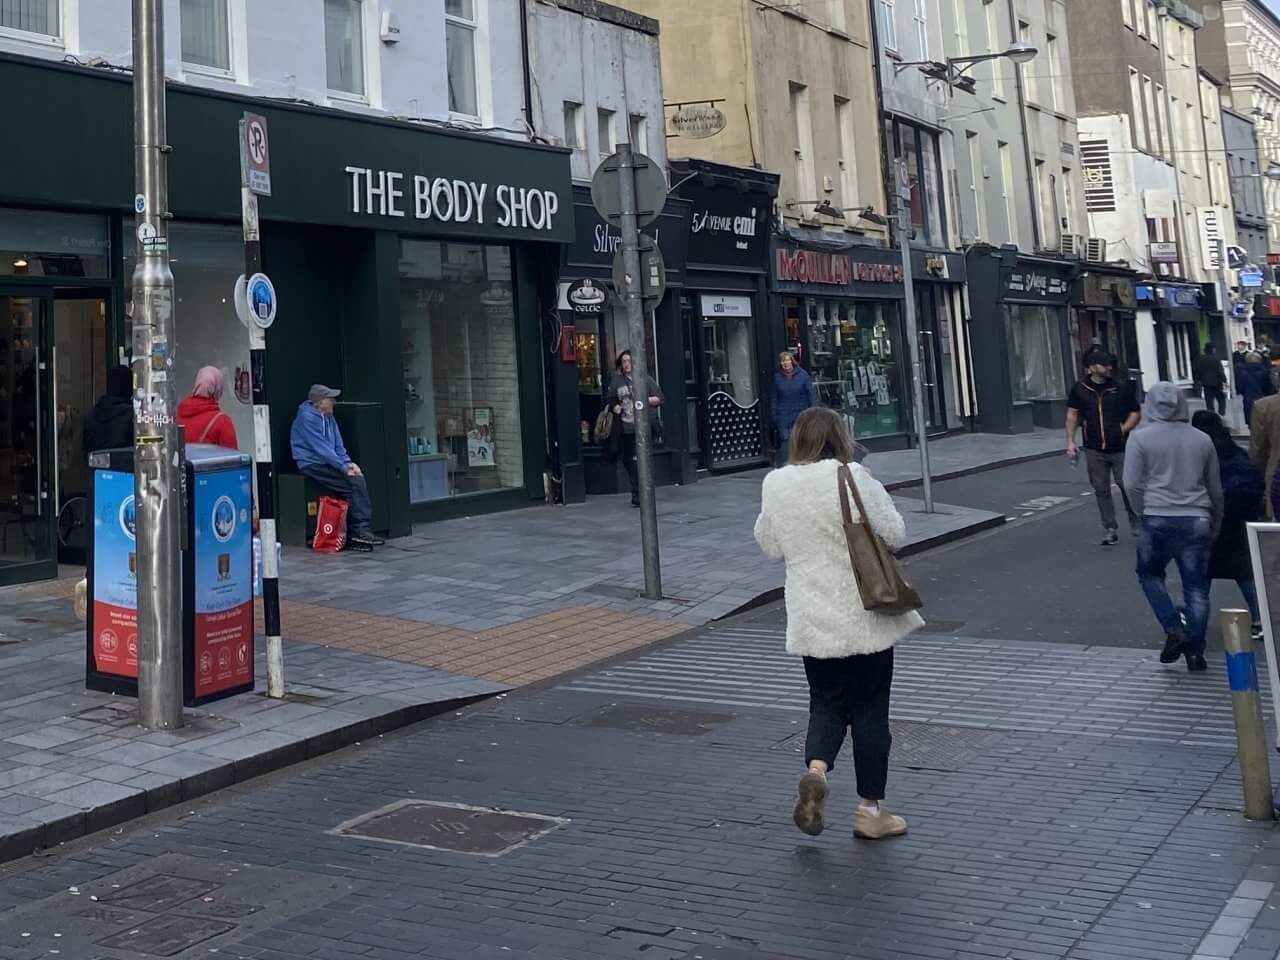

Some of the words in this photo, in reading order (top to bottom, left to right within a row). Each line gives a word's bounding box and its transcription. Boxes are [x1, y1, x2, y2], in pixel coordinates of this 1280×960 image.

[345, 166, 405, 217] THE
[415, 175, 488, 224] BODY
[496, 184, 559, 230] SHOP
[734, 207, 757, 236] emi
[776, 249, 851, 285] McQUILLAN
